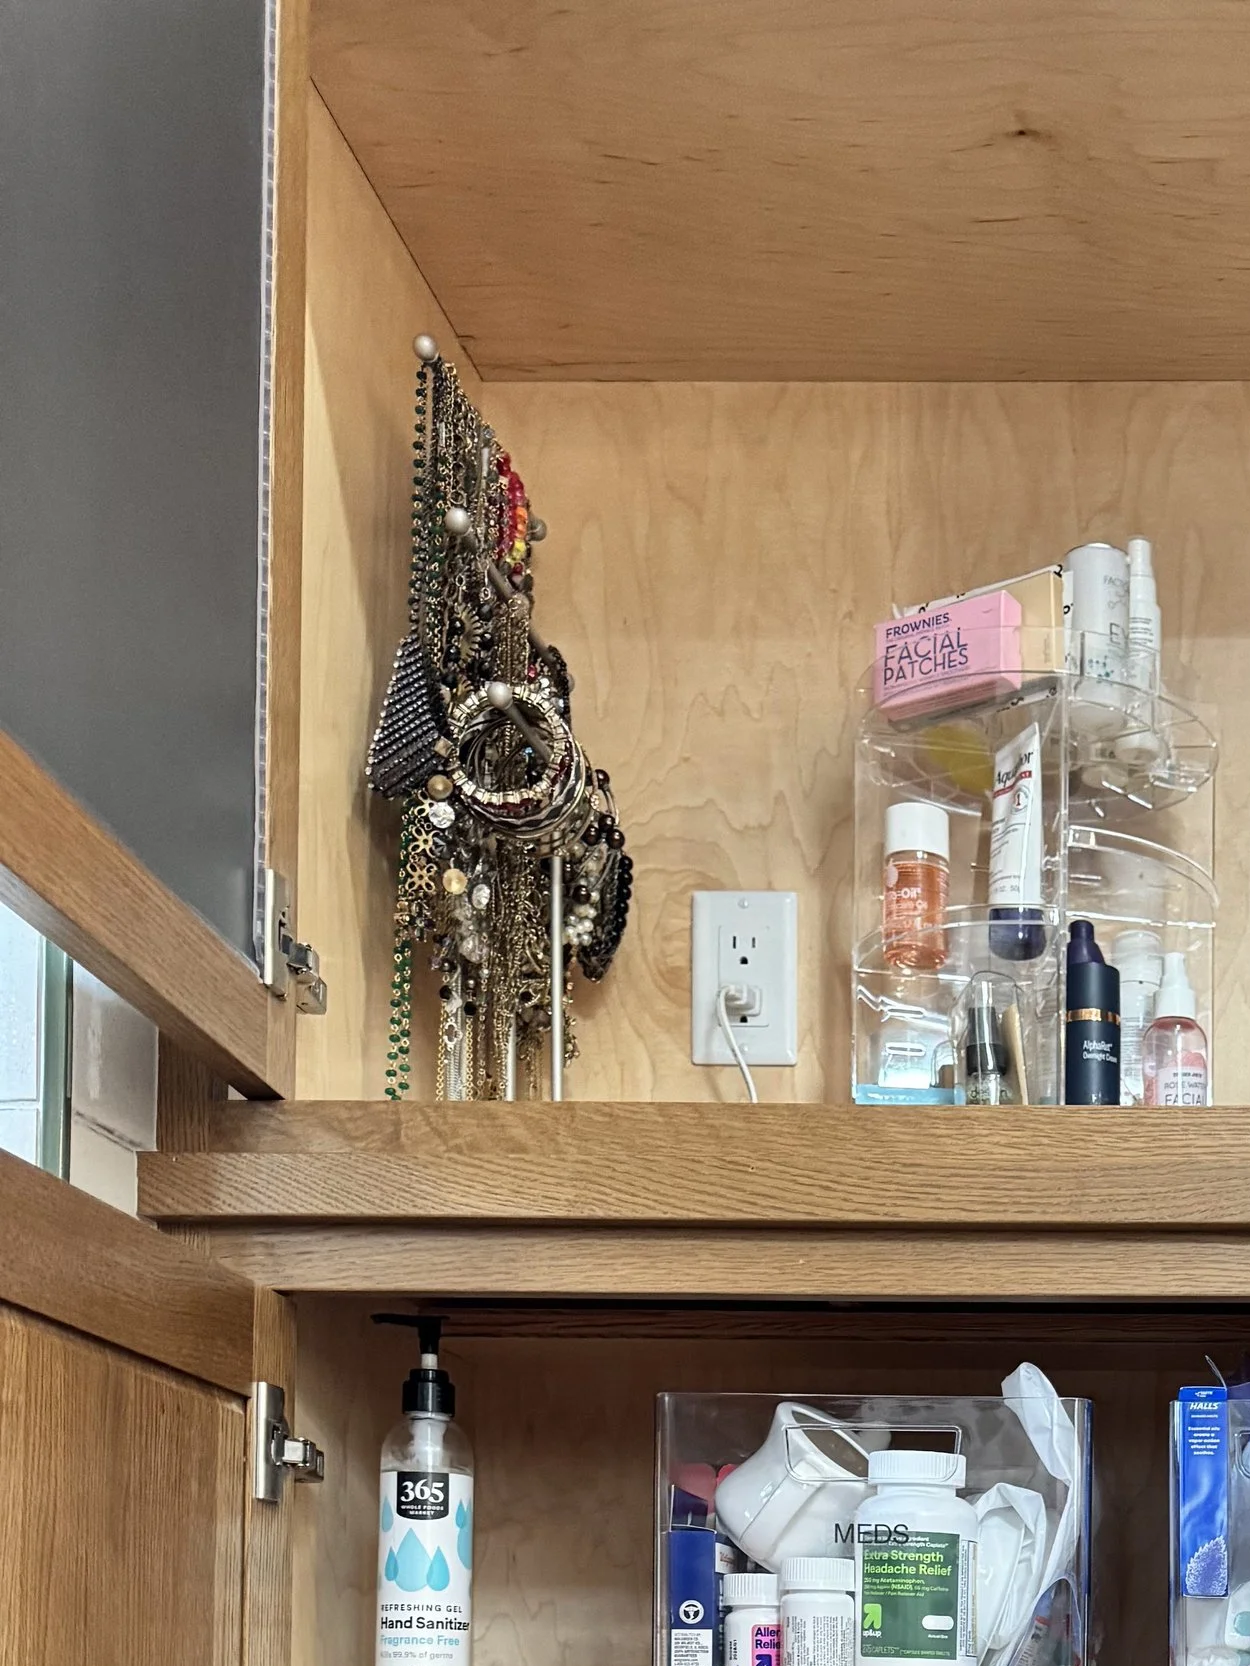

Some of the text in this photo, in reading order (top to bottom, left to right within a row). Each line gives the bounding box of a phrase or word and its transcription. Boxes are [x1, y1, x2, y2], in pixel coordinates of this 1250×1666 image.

[886, 612, 951, 639] FROWNIES
[884, 627, 969, 668] FACIAL
[884, 648, 969, 686] PATCHES
[1189, 1402, 1219, 1410] HALLS
[400, 1479, 445, 1503] 365
[834, 1523, 910, 1544] MEDS
[864, 1550, 944, 1563] Extra Strength
[864, 1563, 953, 1576] Headache Relief
[381, 1603, 463, 1613] REFRESHING GEL
[380, 1616, 470, 1631] Hand Sanitizer
[380, 1635, 460, 1647] Fragrance Free
